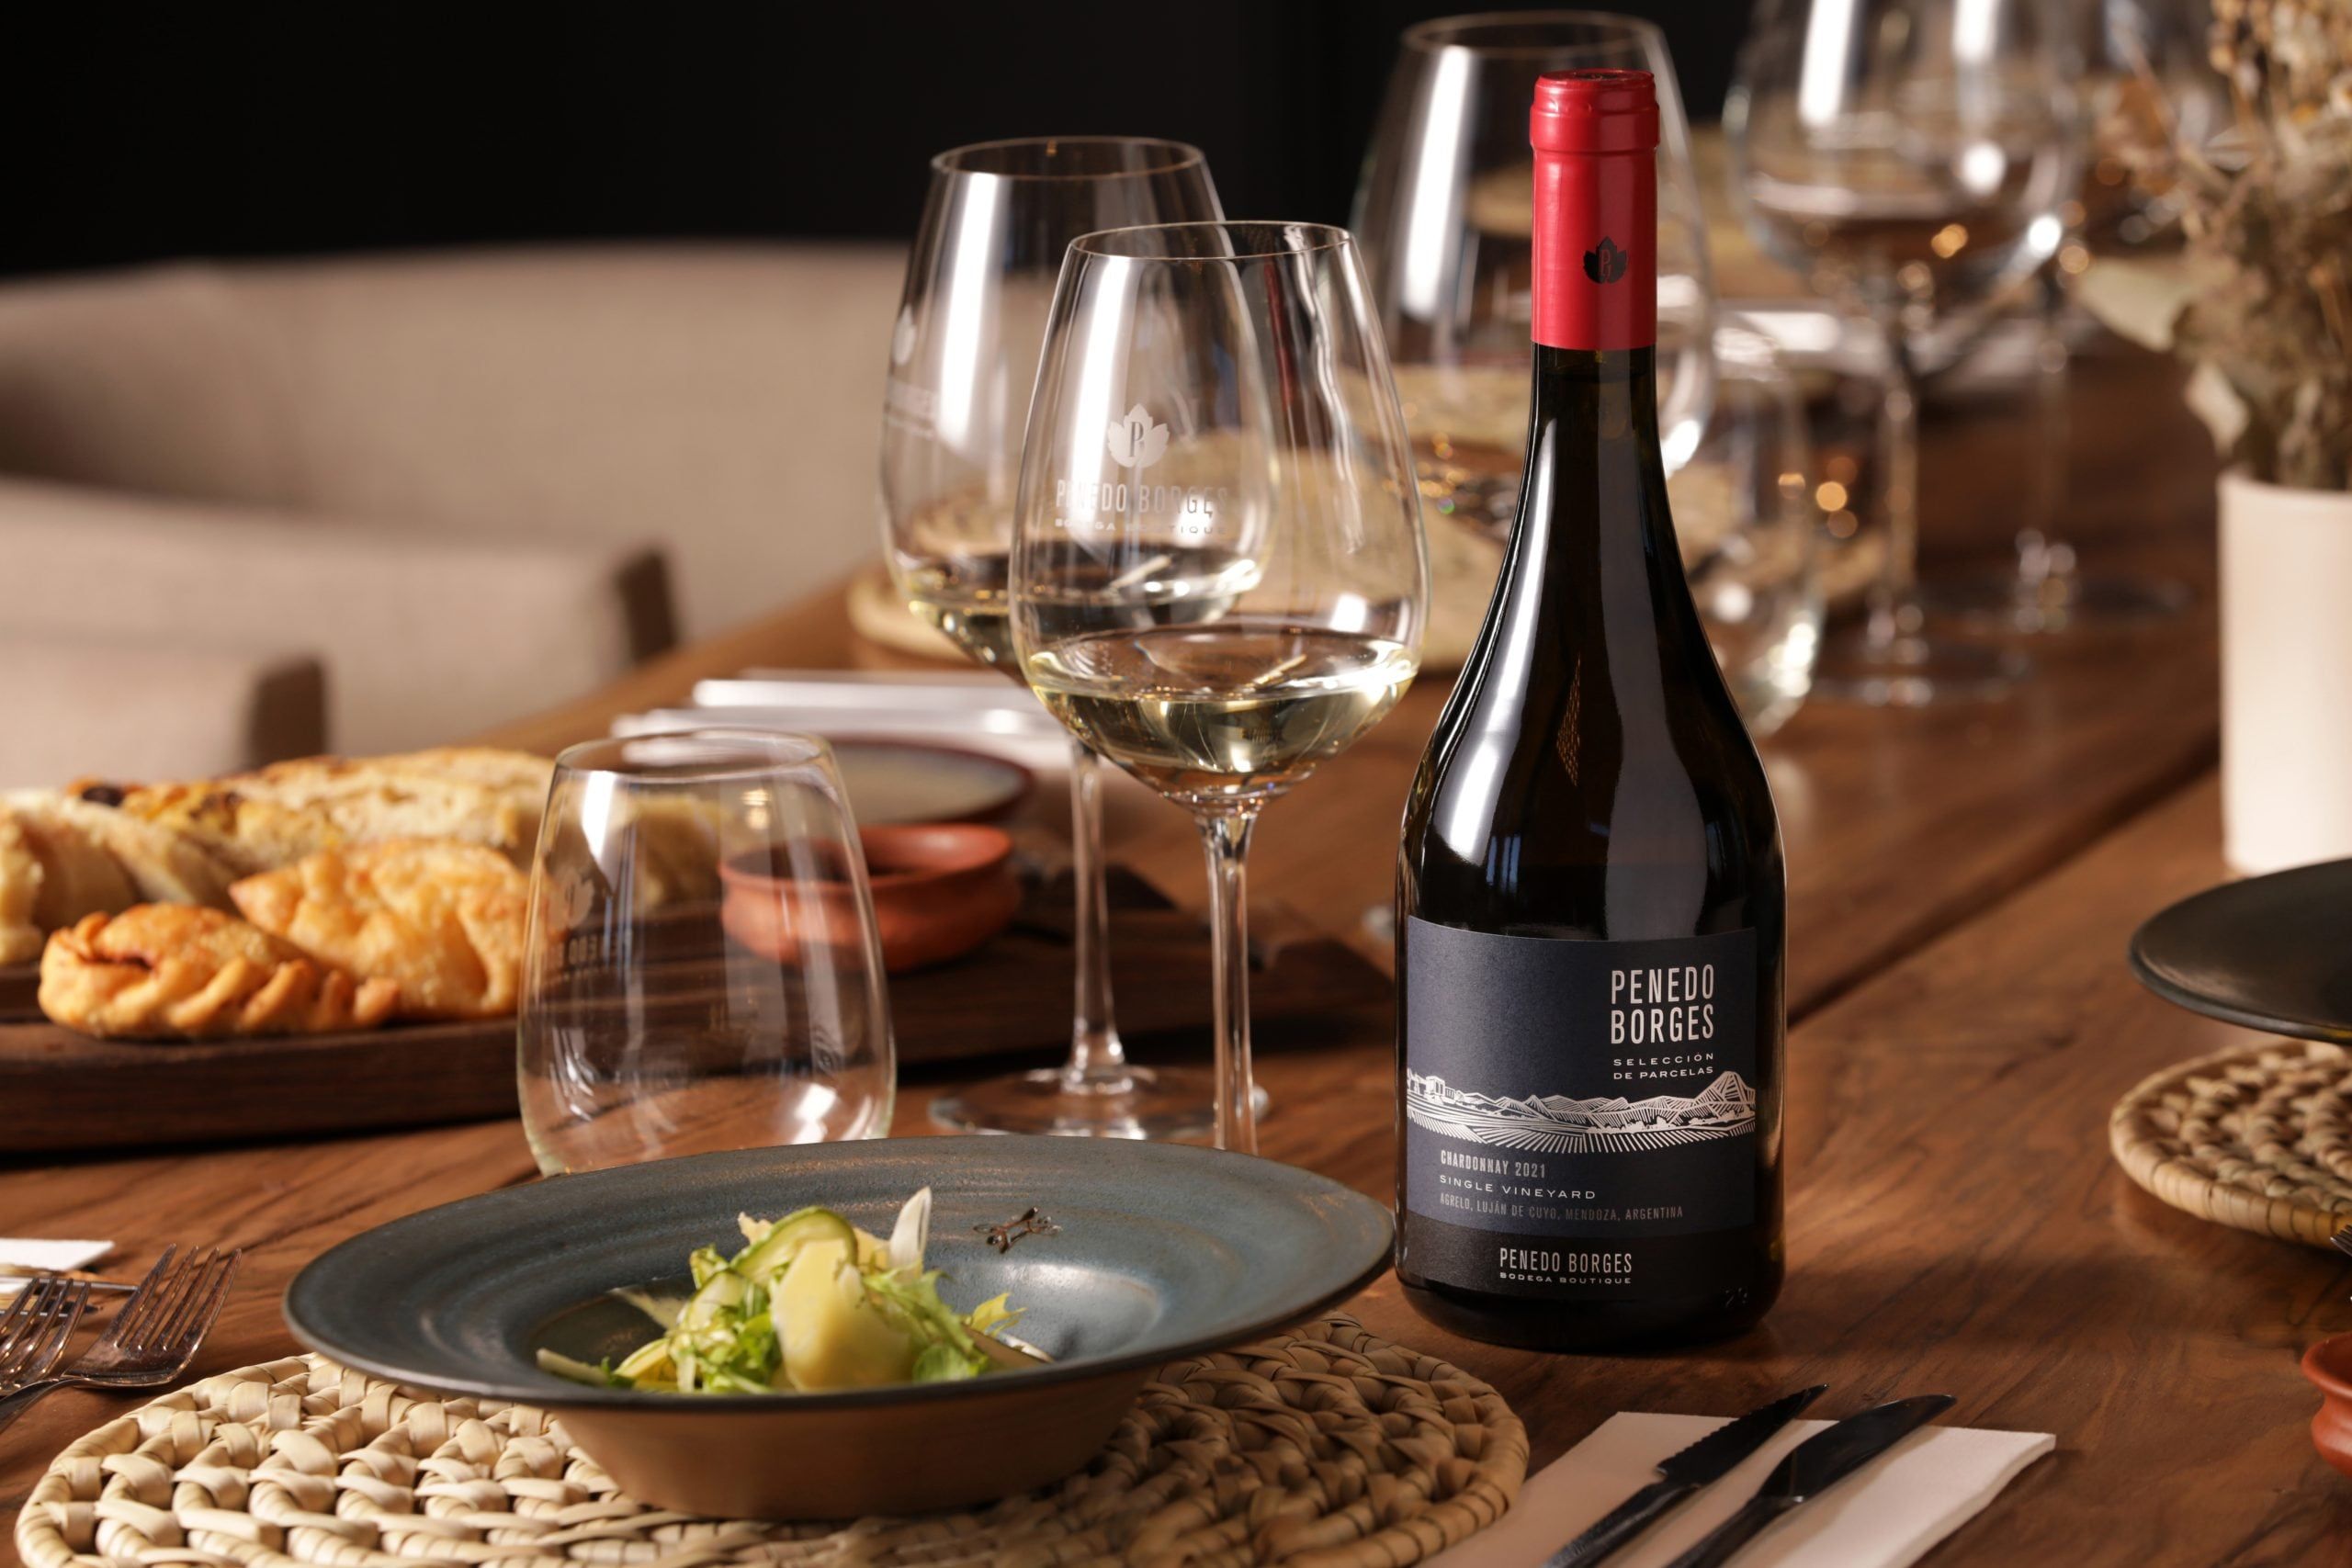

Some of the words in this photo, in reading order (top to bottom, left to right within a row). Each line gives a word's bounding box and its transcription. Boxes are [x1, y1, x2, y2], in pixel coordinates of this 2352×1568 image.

[1611, 964, 1714, 1005] PENEDO
[1611, 1003, 1714, 1044] BORGES
[1613, 1052, 1713, 1066] SELECCIÓN
[1613, 1072, 1633, 1080] DE
[1639, 1066, 1713, 1079] PARCELAS
[1441, 1149, 1509, 1175] CHARDONNAY
[1515, 1161, 1545, 1179] 2021
[1440, 1175, 1493, 1192] SINGLE
[1502, 1185, 1596, 1200] VINEYARD
[1440, 1192, 1474, 1212] AGRELO,
[1476, 1200, 1507, 1215] LUJÁN
[1511, 1204, 1524, 1217] DE
[1529, 1206, 1560, 1221] CUYO,
[1566, 1208, 1621, 1222] MENDOZA,
[1625, 1205, 1683, 1220] ARGENTINA
[1499, 1247, 1560, 1272] PENEDO
[1568, 1252, 1632, 1273] BORGES
[1499, 1271, 1553, 1283] BODEGA
[1559, 1277, 1632, 1285] BOUTIQUE
